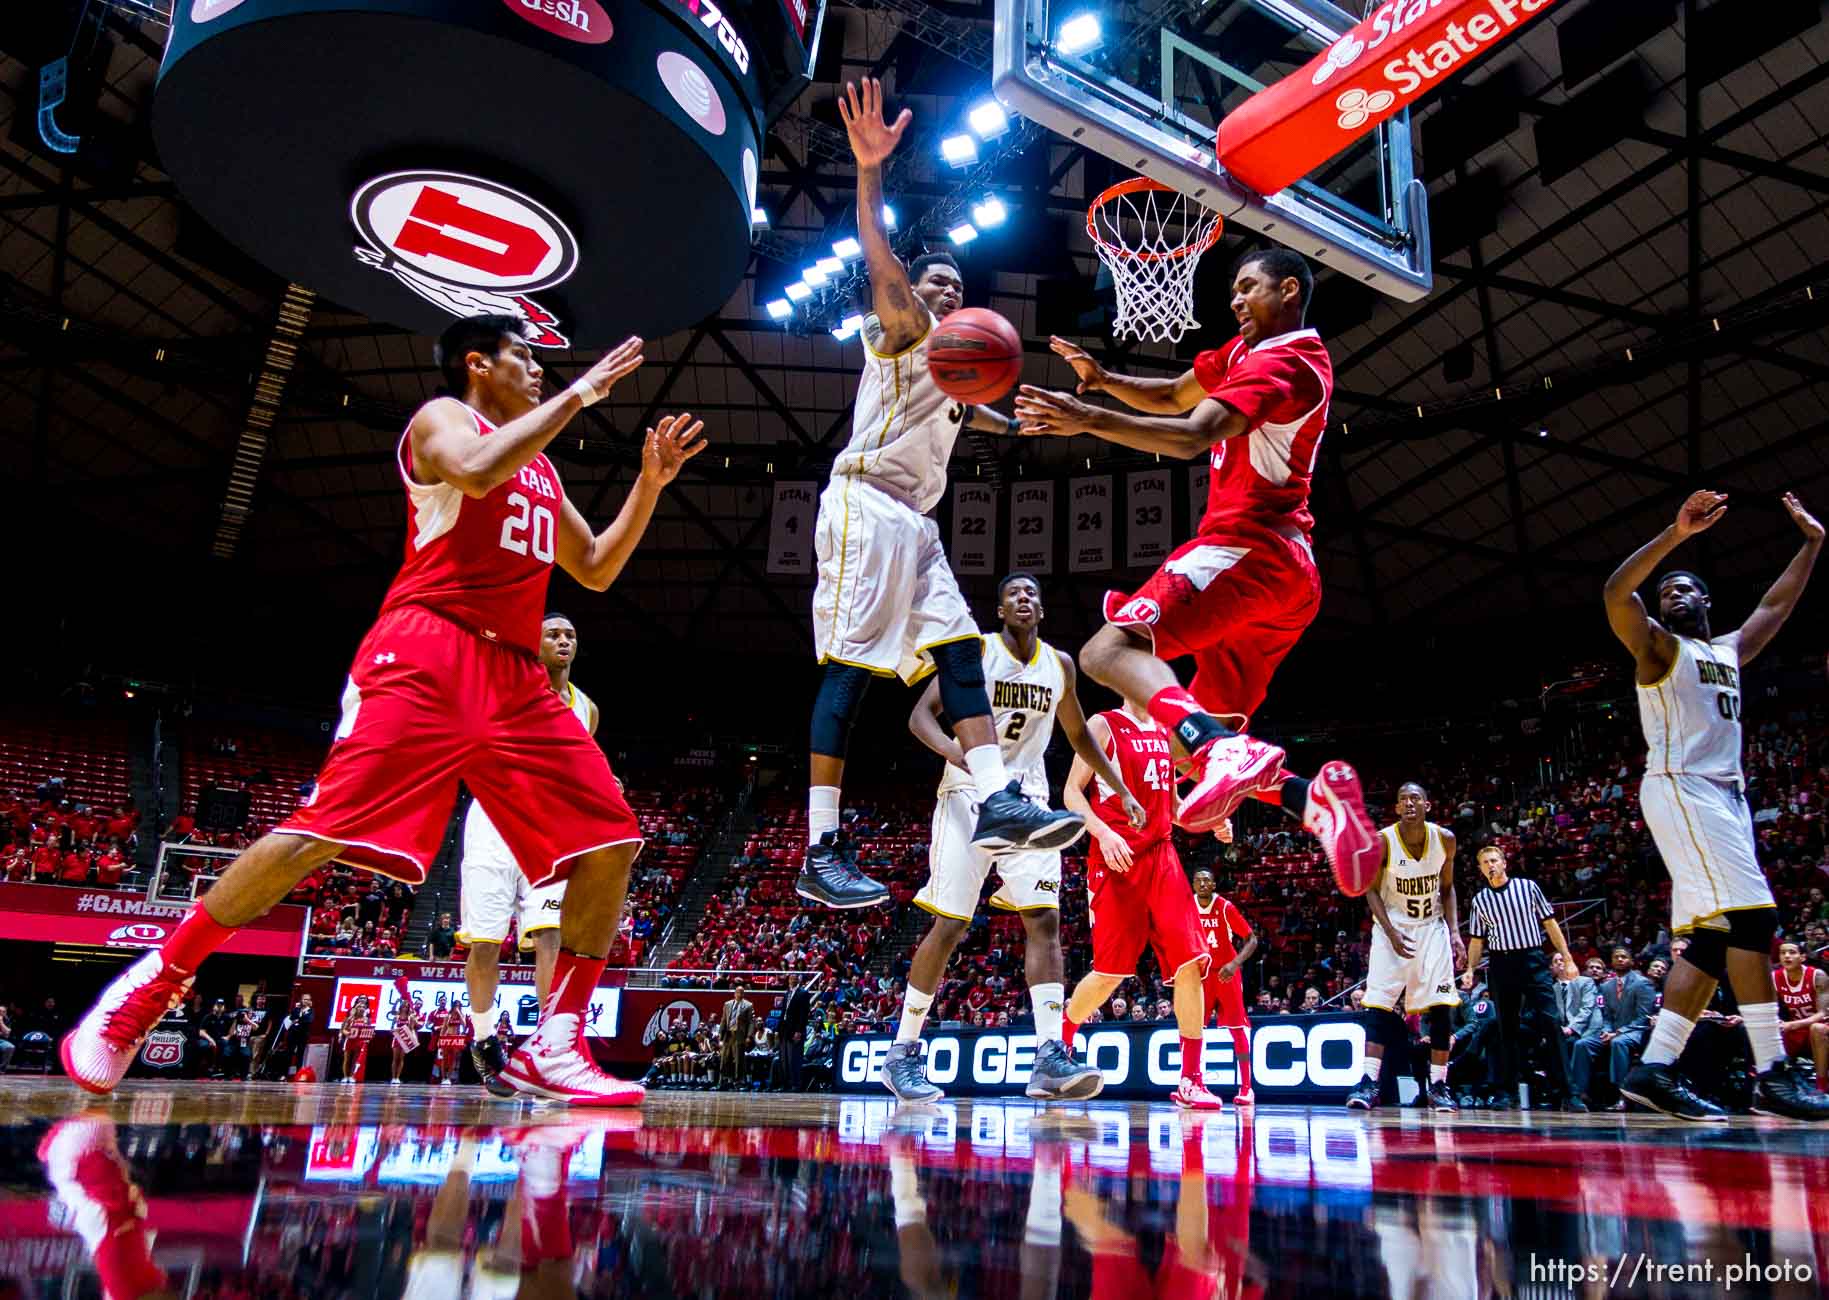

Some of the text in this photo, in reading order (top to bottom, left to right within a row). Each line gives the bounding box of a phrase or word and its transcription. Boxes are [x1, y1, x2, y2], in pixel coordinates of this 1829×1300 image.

[1368, 0, 1440, 48] Sta
[512, 464, 556, 500] TAH
[1134, 479, 1166, 493] UTAH
[779, 488, 812, 504] UTAH
[960, 489, 991, 503] UTAH
[1016, 488, 1048, 503] UTAH
[1075, 484, 1107, 498] UTAH
[1077, 512, 1102, 531] 24
[1135, 506, 1162, 526] 33
[499, 492, 555, 565] 20
[785, 516, 798, 535] 4
[960, 517, 987, 535] 22
[1018, 516, 1043, 535] 23
[992, 680, 1053, 713] HORNETS
[1004, 712, 1026, 741] 2
[1131, 739, 1169, 754] UTAH
[1143, 758, 1169, 791] 42
[1407, 898, 1433, 919] 52
[1200, 918, 1219, 928] TAH
[420, 967, 445, 978] WE
[511, 970, 536, 981] MUS
[1783, 994, 1812, 1005] UTAH
[152, 1035, 180, 1043] PHILLIPS
[440, 1038, 465, 1046] UTAH
[150, 1045, 176, 1060] 66
